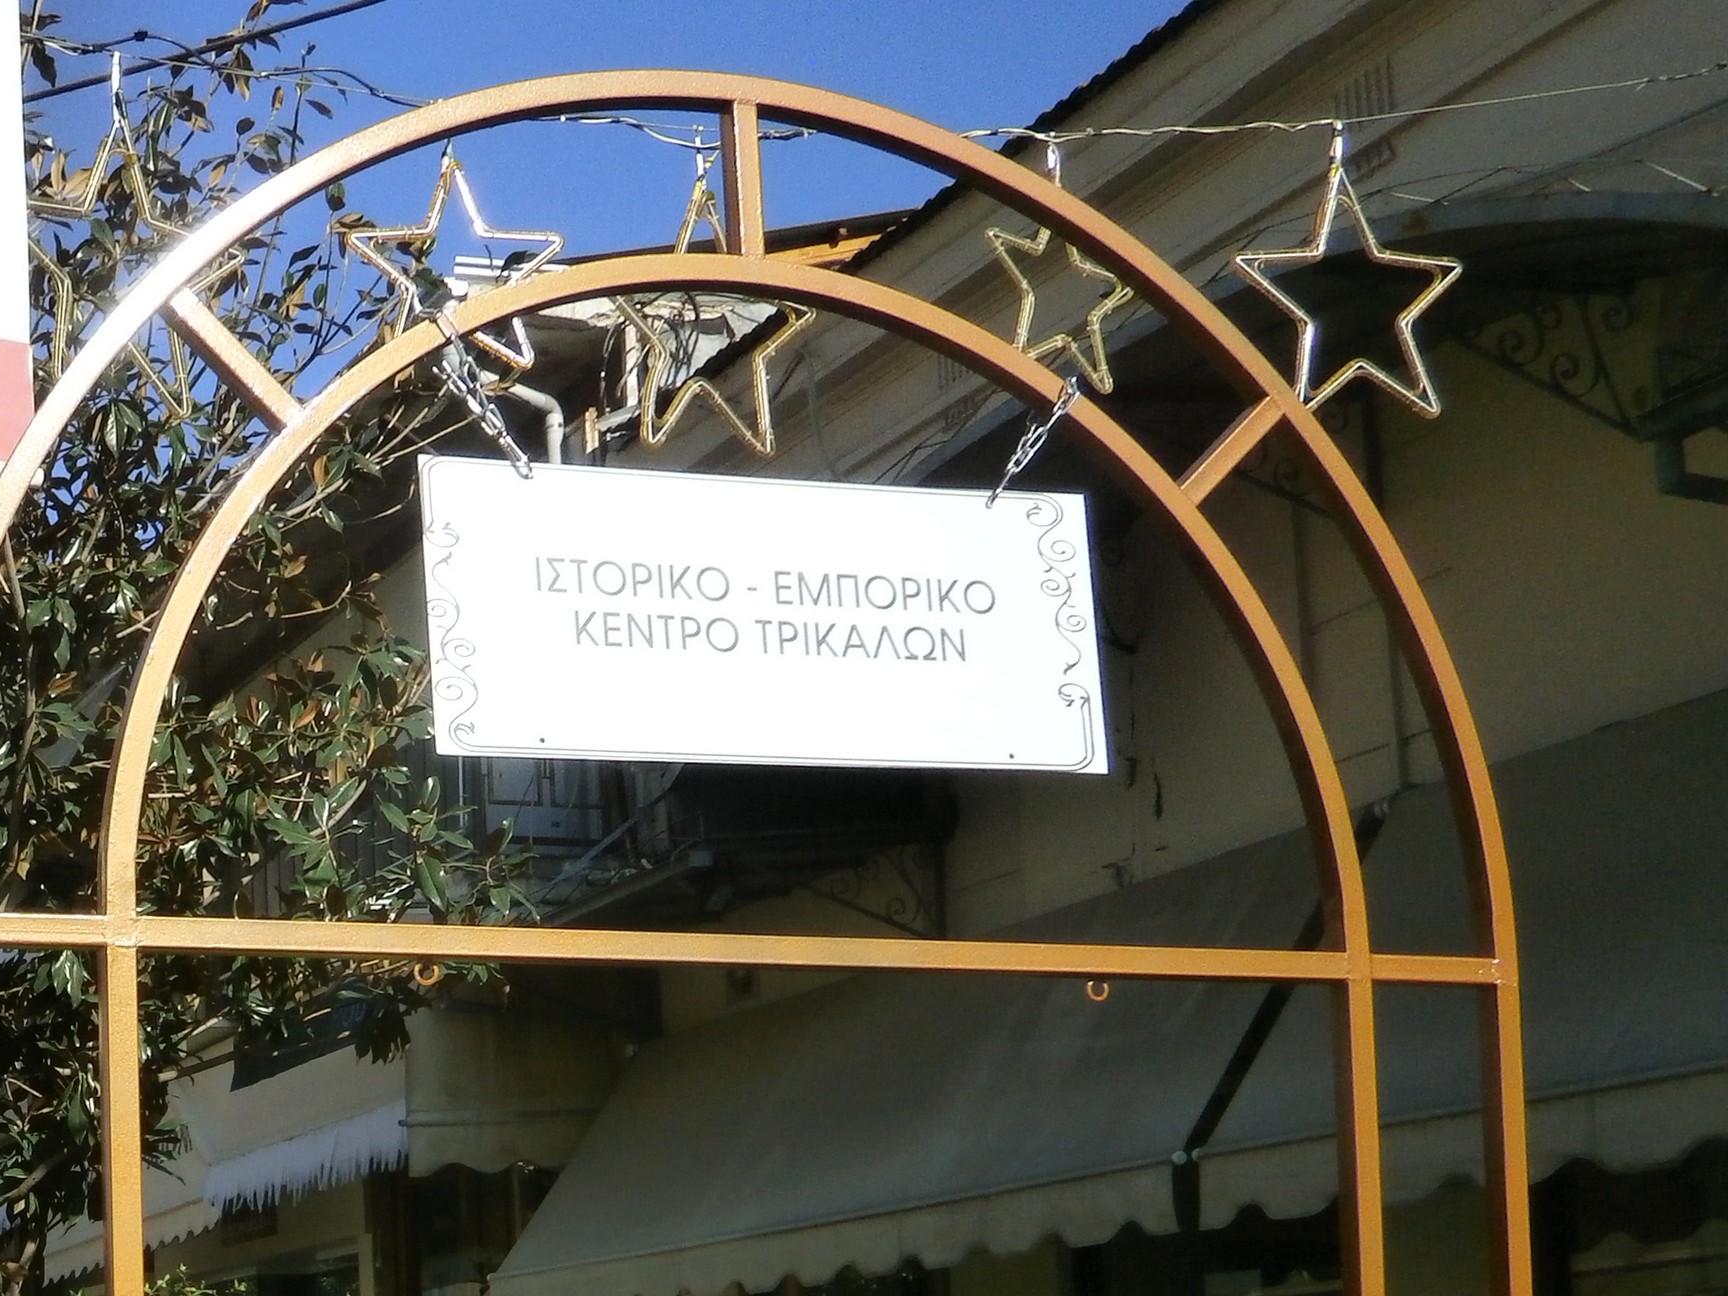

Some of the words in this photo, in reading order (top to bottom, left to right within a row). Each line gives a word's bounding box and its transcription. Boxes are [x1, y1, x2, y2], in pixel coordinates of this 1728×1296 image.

[534, 557, 730, 602] ΙΣΤΟΡΙΚΟ
[774, 570, 996, 614] ΕΜΠΟΡΙΚΟ
[573, 610, 740, 653] ΚΕΝΤΡΟ
[753, 619, 967, 662] ΤΡΙΚΑΛΩΝ
